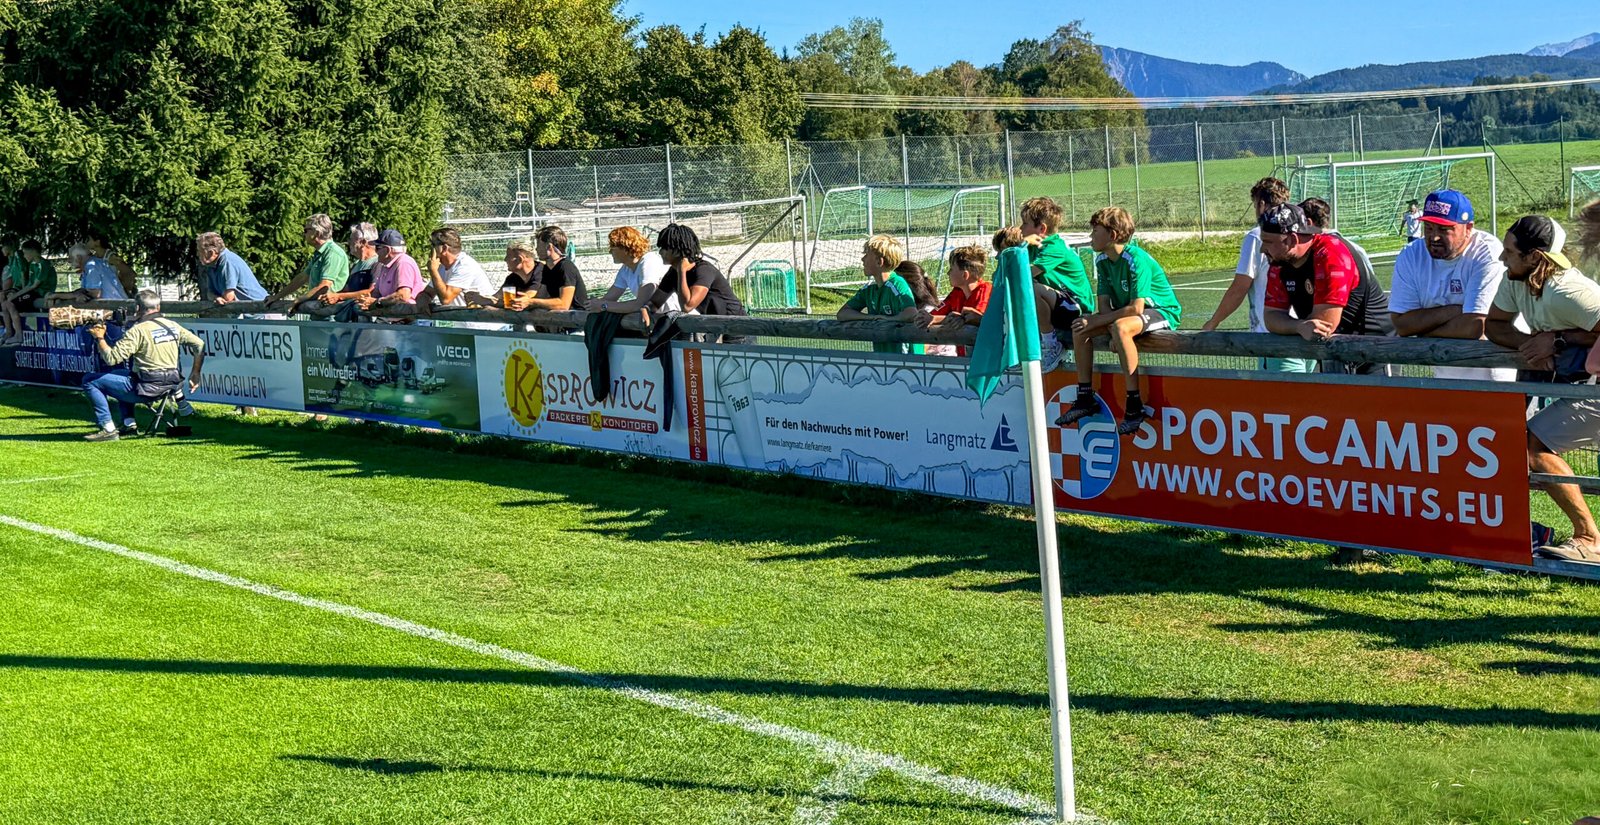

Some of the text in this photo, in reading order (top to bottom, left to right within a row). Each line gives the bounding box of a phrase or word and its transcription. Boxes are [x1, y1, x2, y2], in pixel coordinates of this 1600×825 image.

[179, 325, 294, 362] EL&VÖLKERS
[436, 344, 470, 359] IVECO
[307, 363, 318, 377] ein
[201, 373, 267, 399] IMMOBILIEN
[688, 351, 702, 460] www.kasprowicz.de
[733, 396, 750, 413] 1963
[603, 417, 656, 433] KONDITOREI
[765, 416, 909, 442] Für den Nachwuchs mit Power!
[926, 428, 987, 451] Langmatz
[1132, 405, 1499, 479] SPORTCAMPS
[1132, 460, 1504, 528] WWW.CROEVENTS.EU
